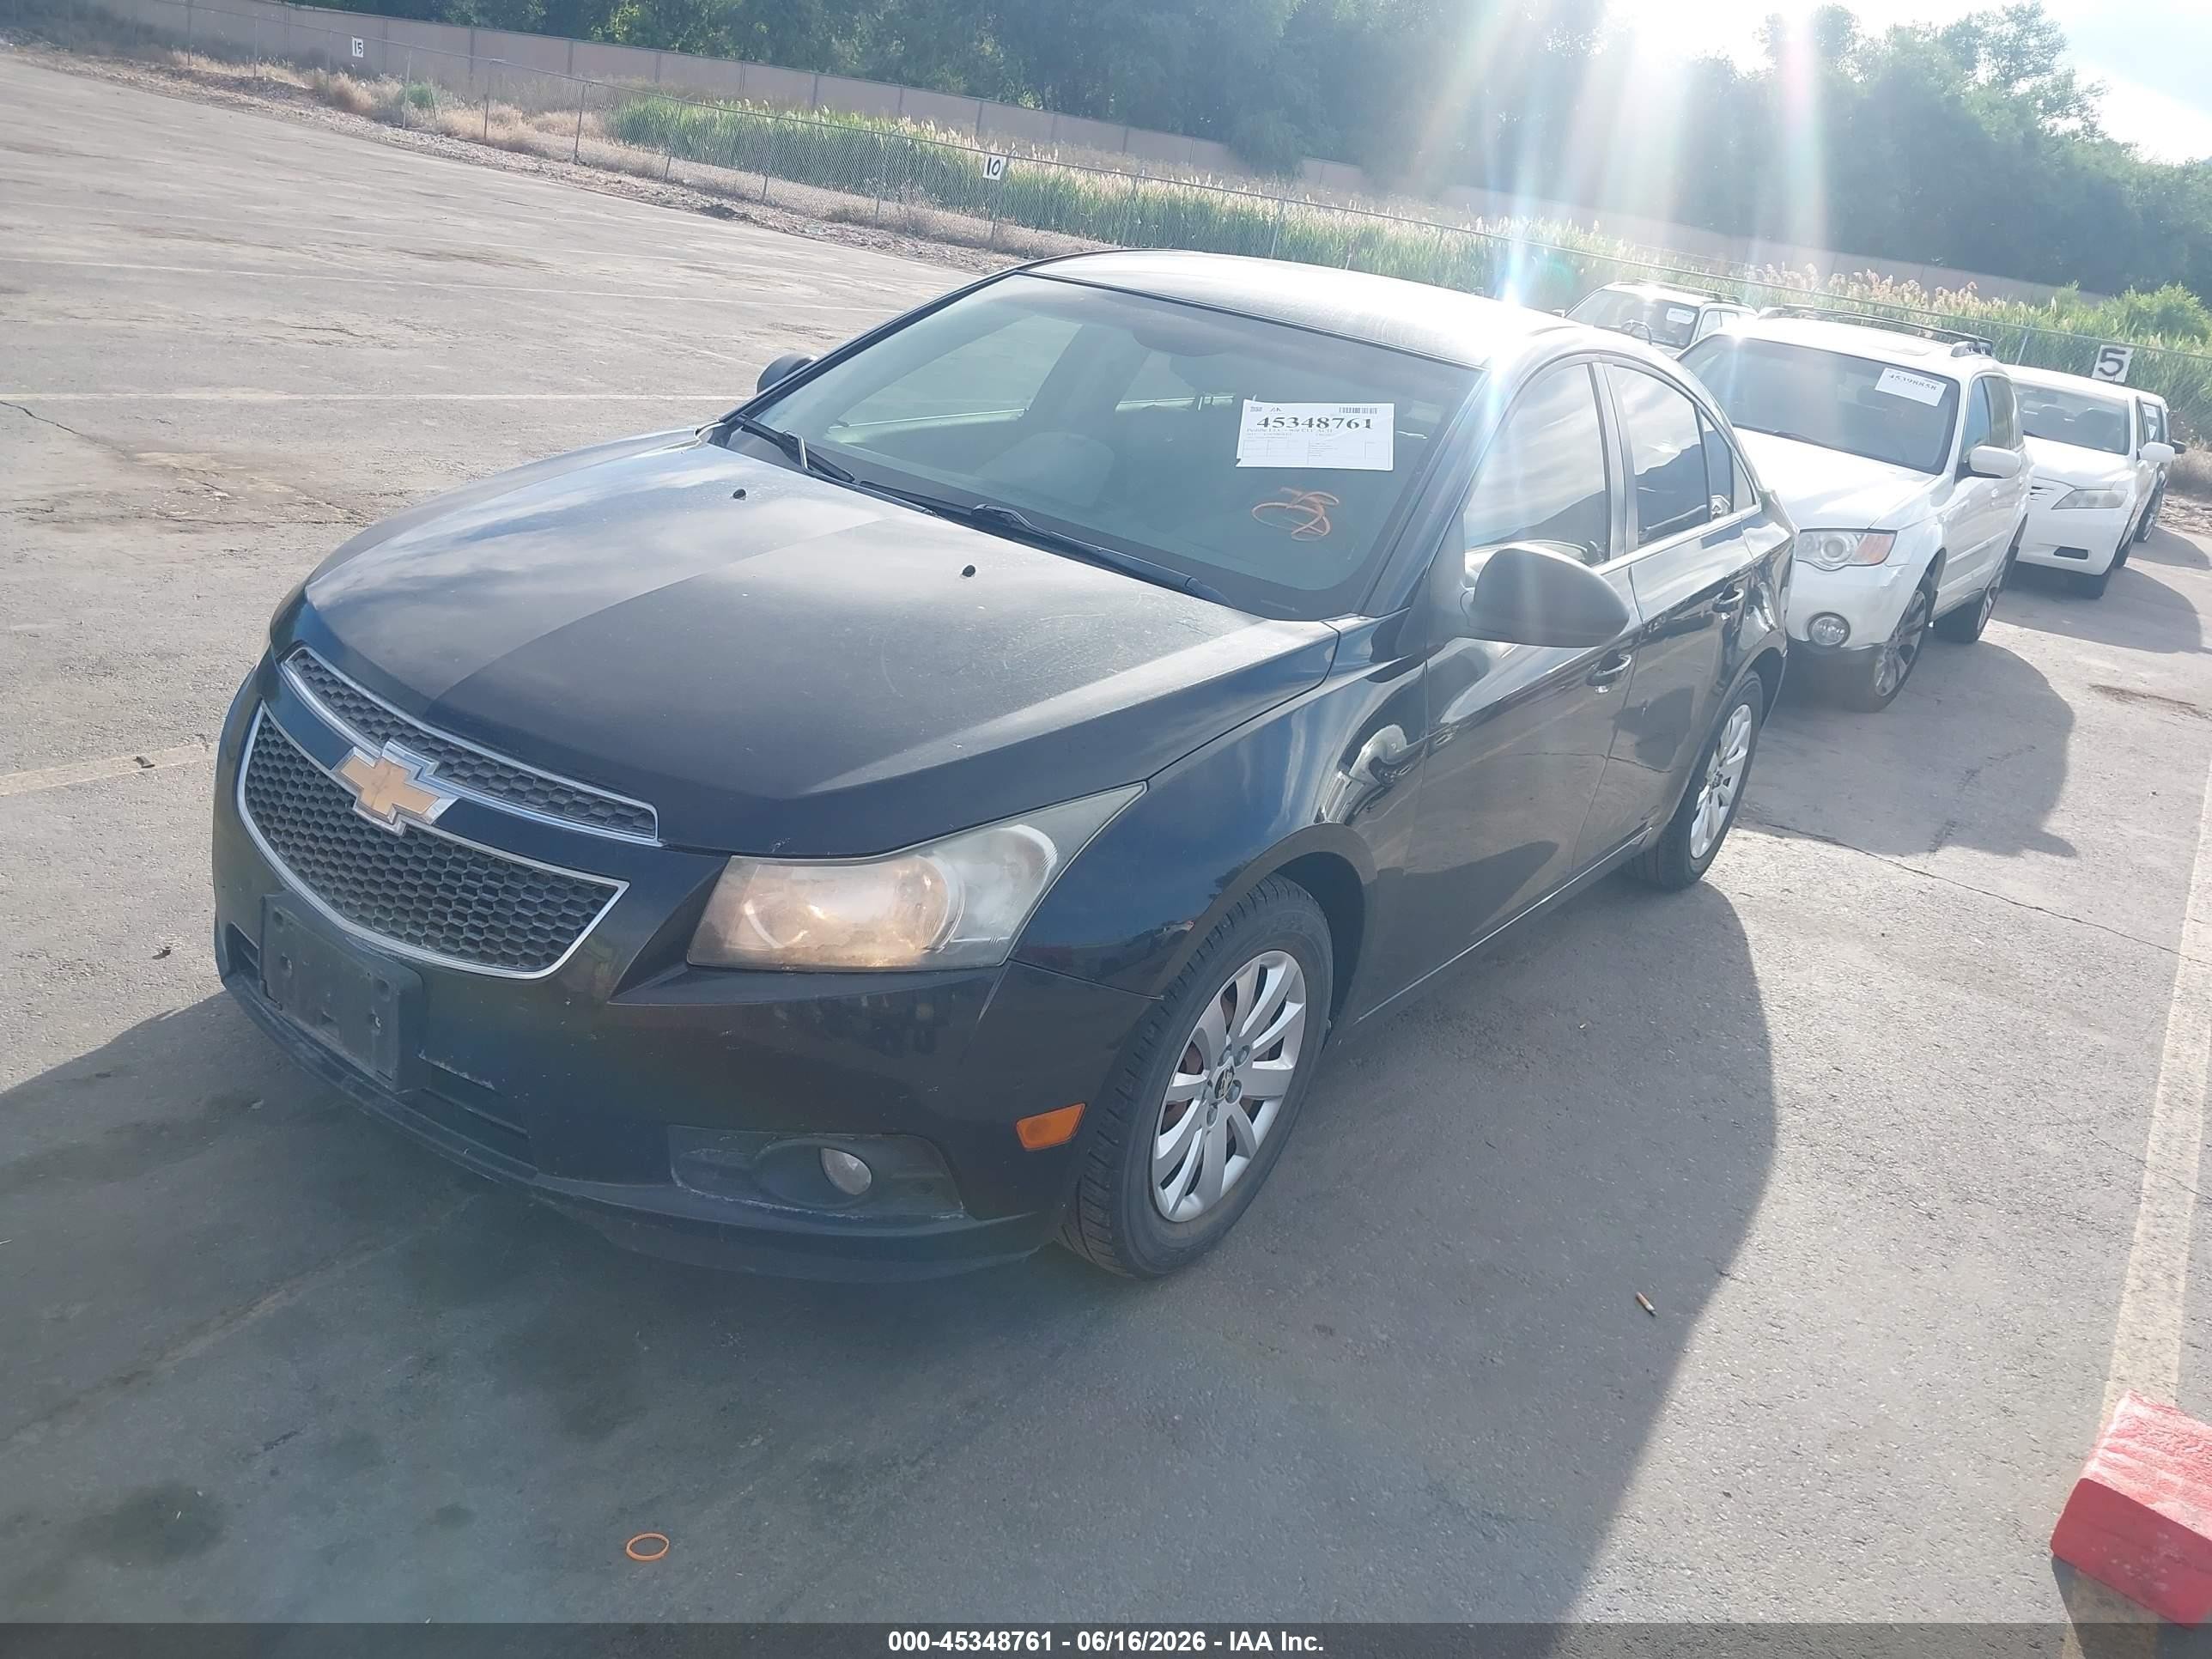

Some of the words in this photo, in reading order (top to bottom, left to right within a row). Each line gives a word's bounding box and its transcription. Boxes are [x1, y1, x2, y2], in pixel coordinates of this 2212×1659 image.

[354, 40, 362, 55] 15
[987, 157, 1001, 176] 10
[2098, 348, 2127, 377] 5
[1256, 416, 1374, 429] 45348761
